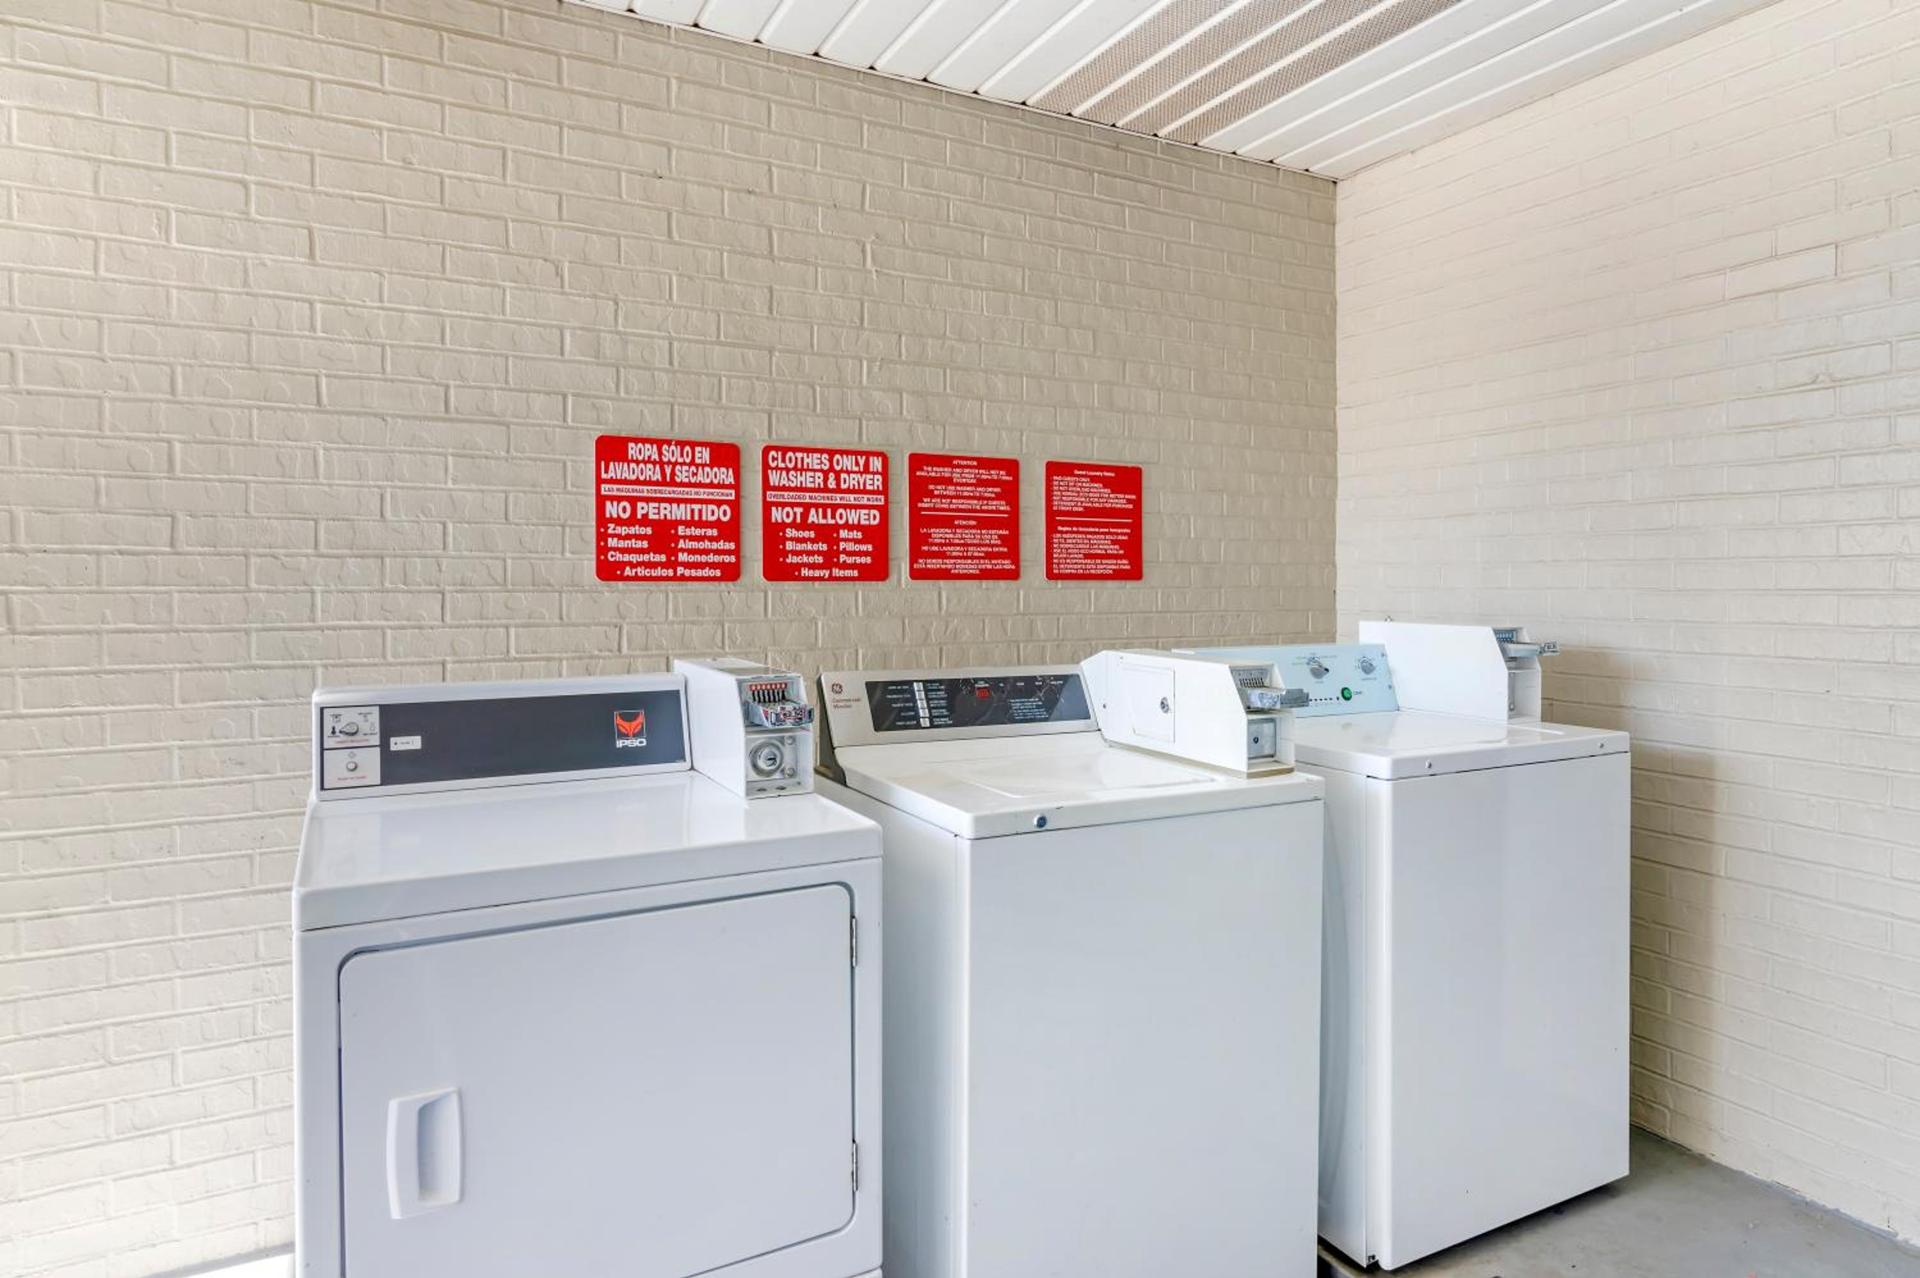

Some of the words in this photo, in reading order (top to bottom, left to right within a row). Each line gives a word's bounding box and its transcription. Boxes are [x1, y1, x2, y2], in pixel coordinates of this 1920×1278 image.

[628, 442, 658, 461] ROPA
[662, 441, 692, 464] SÓLO
[695, 447, 709, 464] EN
[768, 451, 829, 470] CLOTHES
[833, 454, 865, 471] ONLY
[870, 456, 882, 472] IN
[601, 462, 661, 481] LAVADORA
[665, 465, 672, 482] Y
[675, 466, 734, 484] SECADORA
[768, 470, 823, 488] WASHER
[828, 473, 836, 488] &
[841, 473, 882, 490] DRYER
[605, 501, 630, 518] NO
[637, 503, 731, 521] PERMITIDO
[772, 507, 803, 523] NOT
[808, 508, 880, 525] ALLOWED
[607, 524, 652, 535] Zapatos
[678, 526, 718, 536] Esteras
[786, 528, 815, 538] Shoes
[840, 530, 862, 538] Mats
[608, 538, 648, 548] Mantas
[678, 540, 735, 549] Almohadas
[786, 541, 827, 551] Blankets
[840, 542, 872, 551] Pillows
[608, 552, 666, 563] Chaquetas
[678, 553, 736, 562] Monederos
[786, 554, 823, 563] Jackets
[840, 554, 871, 563] Purses
[677, 567, 721, 576] Pesados
[801, 568, 829, 578] Heavy
[832, 568, 858, 576] Items
[616, 738, 647, 748] IPSO
